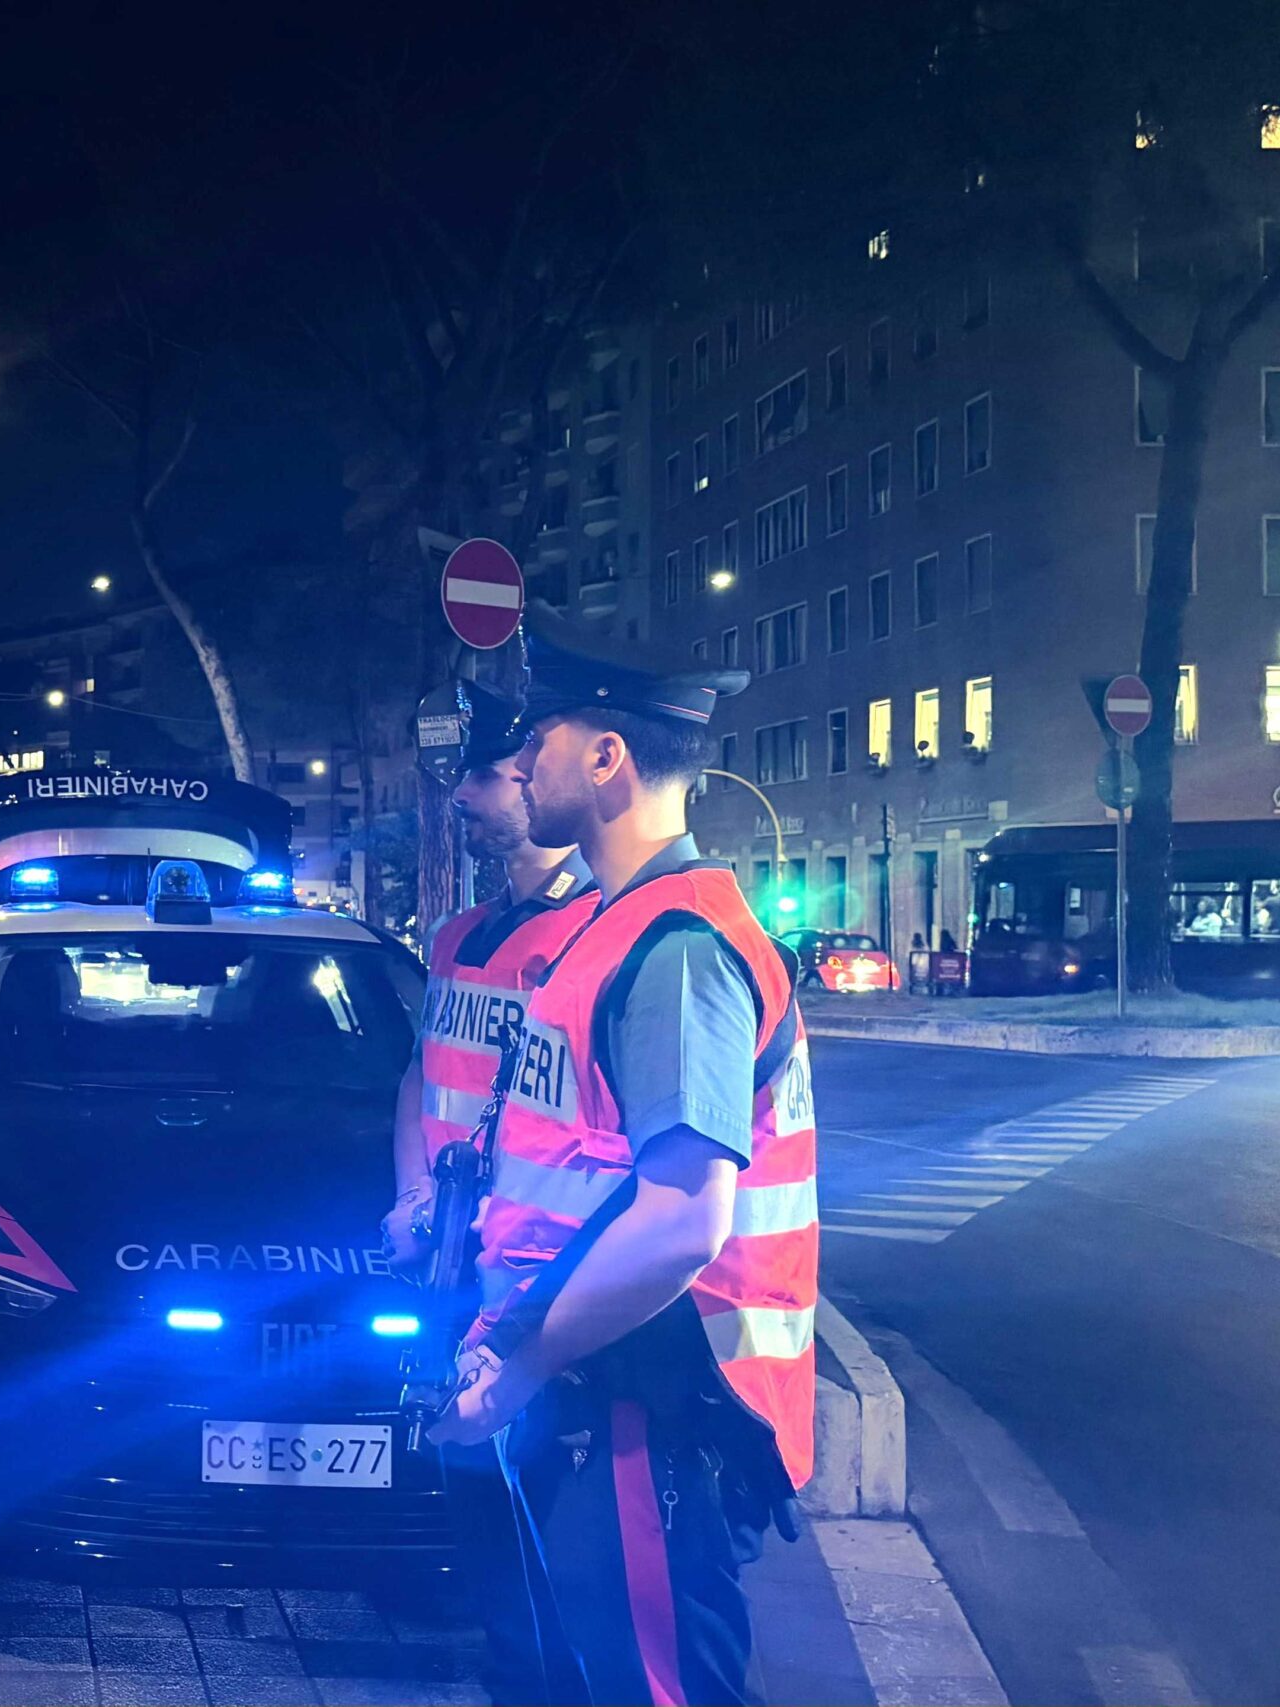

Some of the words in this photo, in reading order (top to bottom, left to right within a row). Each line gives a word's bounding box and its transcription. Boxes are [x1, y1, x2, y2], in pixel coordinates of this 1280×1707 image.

[28, 776, 208, 801] CARABINIERI
[206, 1435, 245, 1469] CC
[268, 1437, 306, 1472] ES
[327, 1439, 387, 1474] 277
